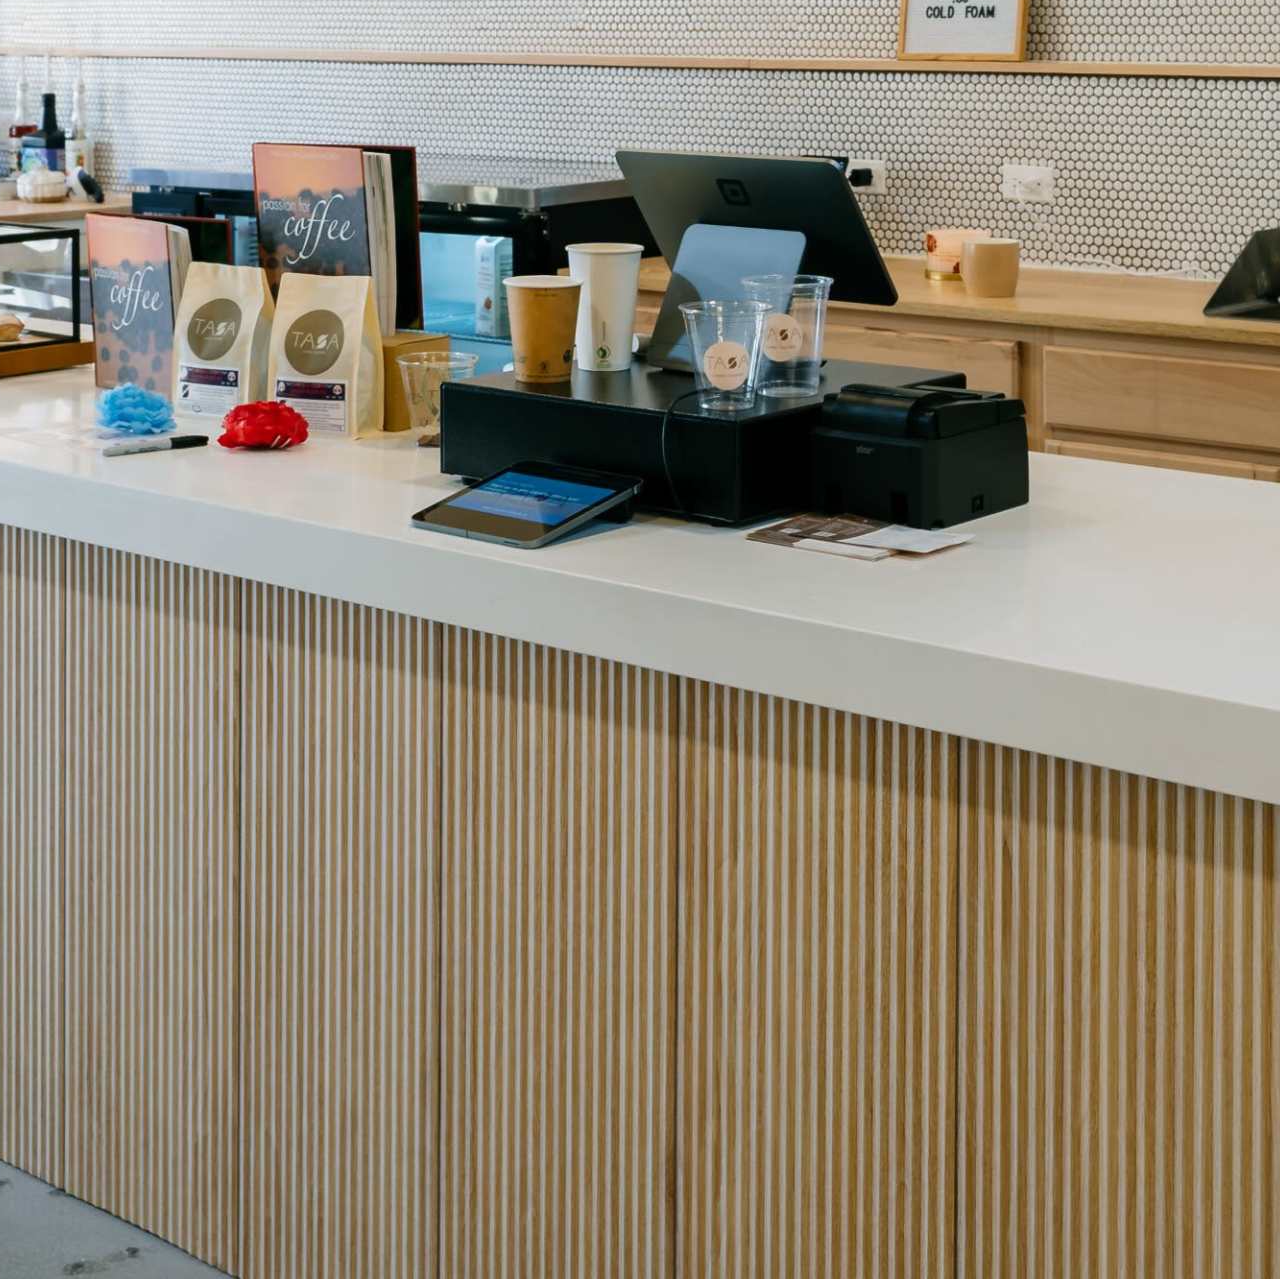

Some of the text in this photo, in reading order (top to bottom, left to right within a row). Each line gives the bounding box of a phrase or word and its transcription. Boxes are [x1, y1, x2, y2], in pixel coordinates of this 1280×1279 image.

[926, 6, 995, 18] COLD FOAM
[284, 194, 355, 264] coffee
[110, 266, 164, 330] coffee
[194, 318, 236, 337] TASA
[292, 331, 340, 350] TASA
